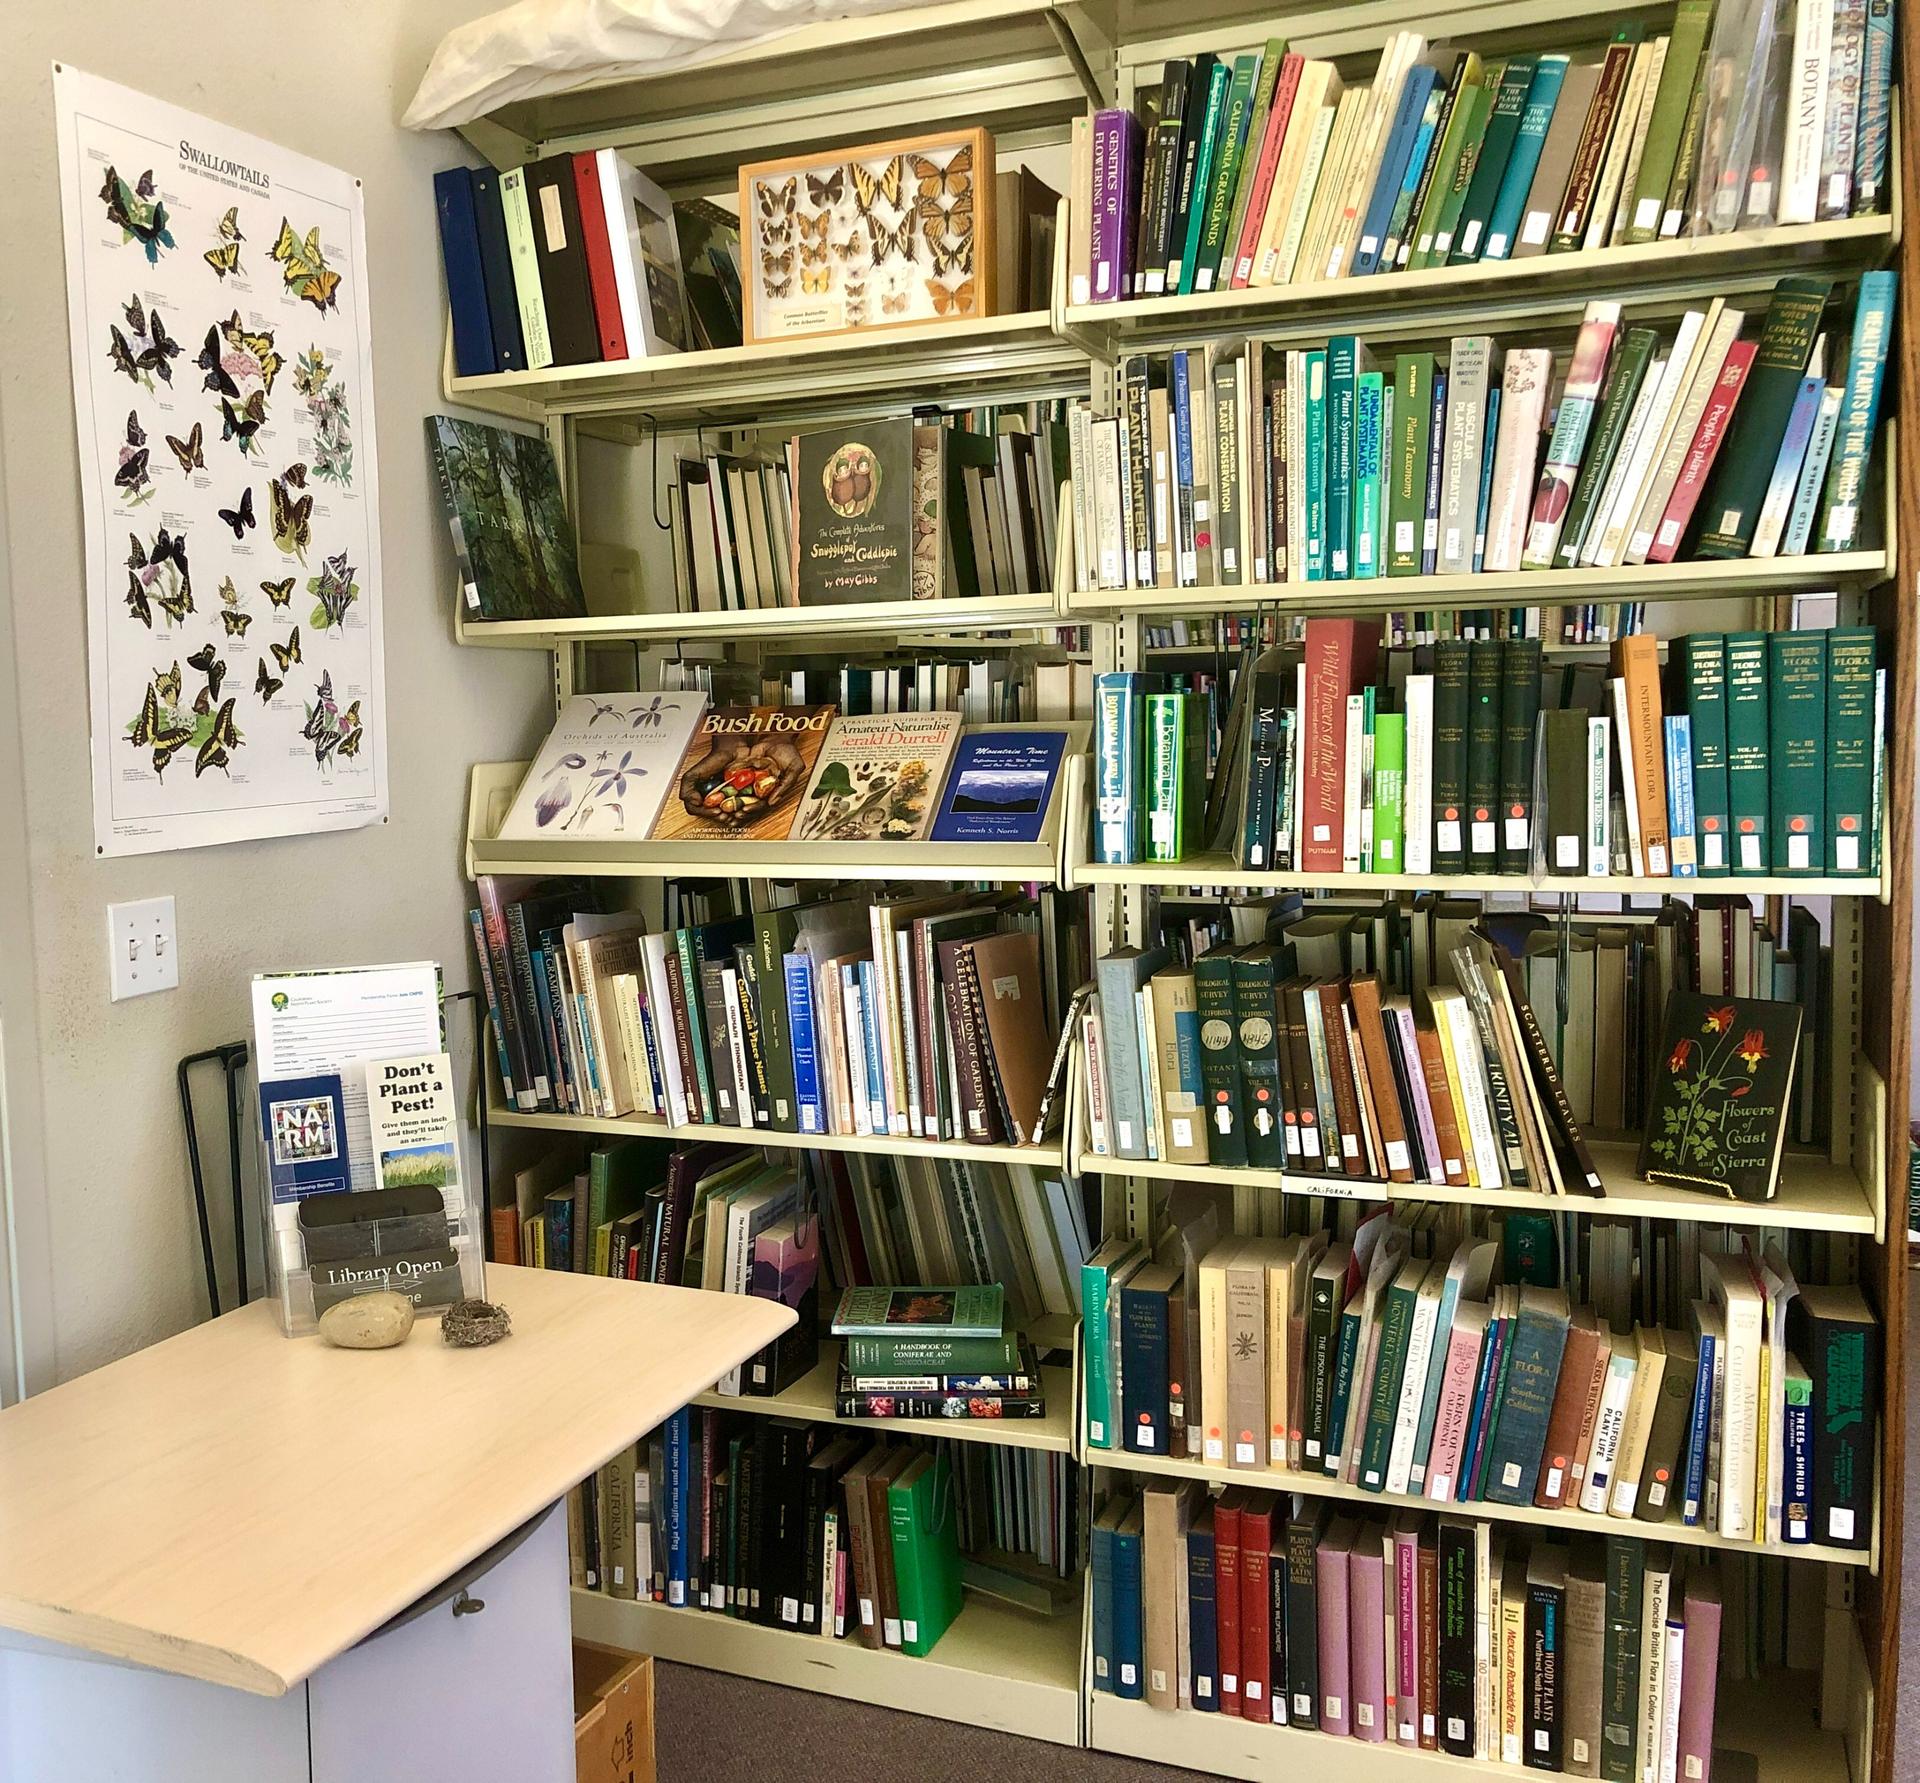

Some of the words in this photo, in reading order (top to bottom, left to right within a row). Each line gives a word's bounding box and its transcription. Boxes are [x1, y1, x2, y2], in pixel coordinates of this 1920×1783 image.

[1800, 58, 1820, 132] BOTANY
[1221, 100, 1240, 169] CALIFORNIA
[180, 140, 270, 189] SWALLOWTAILS
[1108, 131, 1118, 190] GENETICS
[1109, 197, 1118, 215] OF
[1209, 172, 1229, 247] GRASSLANDS
[1859, 309, 1882, 359] HEALTH
[1851, 360, 1874, 410] PLANTS
[1341, 390, 1351, 417] Plant
[1360, 387, 1368, 416] PLANT
[1219, 400, 1229, 434] PLANT
[1369, 390, 1377, 461] FUNDAMENTALS
[1406, 416, 1417, 443] Plant
[1452, 402, 1464, 438] PLANT
[1463, 402, 1474, 459] VASCULAR
[1697, 402, 1726, 451] People's
[1848, 410, 1865, 427] OF
[1340, 420, 1351, 479] Systematics
[1359, 419, 1368, 480] SYSTEMATICS
[1843, 430, 1862, 456] THE
[1220, 436, 1230, 513] CONSERVATION
[1369, 464, 1377, 475] OF
[1403, 446, 1416, 499] Taxonomy
[1449, 441, 1463, 516] SYSTEMATICS
[1683, 448, 1708, 487] plants
[1836, 457, 1858, 503] WORLD
[811, 541, 858, 560] Snugglepot
[856, 546, 898, 562] Cuddlepie
[825, 579, 833, 588] by
[835, 576, 851, 587] May
[852, 575, 878, 586] Gibbs
[1322, 640, 1339, 677] Wild
[1694, 661, 1721, 670] FLORA
[1733, 662, 1761, 670] FLORA
[1784, 658, 1819, 666] FLORA
[1834, 657, 1871, 666] FLORA
[1321, 677, 1338, 734] Flowers
[701, 711, 759, 734] Bush
[765, 711, 830, 733] Food
[836, 723, 891, 735] Amateur
[892, 721, 951, 734] Naturalist
[842, 732, 886, 746] erald
[887, 731, 947, 745] Durrell
[975, 747, 1021, 756] Mountain
[1026, 746, 1049, 756] Time
[1321, 735, 1337, 747] of
[1640, 685, 1653, 768] INTERMOUNTAIN
[1647, 770, 1656, 801] FLORA
[1320, 748, 1337, 768] the
[1320, 768, 1337, 813] World
[957, 827, 986, 835] Kenneth
[998, 827, 1019, 835] Norris
[542, 936, 553, 956] THE
[953, 947, 964, 956] A
[545, 958, 561, 1020] GRAMPIANS
[955, 959, 975, 1041] CELEBRATION
[730, 1005, 739, 1038] CHUMASH
[966, 1042, 977, 1057] OF
[1166, 1042, 1176, 1071] Flora
[1181, 1034, 1192, 1080] Arizona
[384, 1062, 435, 1080] Don't
[734, 1042, 745, 1092] ETHNOBOTANY
[1519, 1003, 1560, 1085] SCATTERED
[1553, 1088, 1583, 1145] LEAVES
[379, 1081, 429, 1098] Plant
[433, 1081, 443, 1091] a
[969, 1060, 985, 1115] GARDENS
[281, 1107, 323, 1129] NA
[391, 1097, 435, 1114] Pest!
[1719, 1099, 1775, 1133] Flowers
[381, 1121, 398, 1129] Give
[400, 1119, 419, 1128] them
[431, 1115, 447, 1124] inch
[387, 1129, 401, 1138] and
[402, 1126, 426, 1137] they'll
[284, 1127, 325, 1149] RM
[1726, 1129, 1766, 1152] Coast
[1699, 1158, 1715, 1168] and
[1713, 1153, 1766, 1178] Sierra
[328, 1266, 392, 1287] Library
[395, 1259, 444, 1278] Open
[1092, 1283, 1100, 1312] MARIN
[1092, 1312, 1100, 1340] FLORA
[1382, 1298, 1401, 1358] MONTEREY
[893, 1351, 933, 1359] CONIFERAE
[901, 1343, 939, 1351] HANDBOOK
[1318, 1335, 1326, 1350] THE
[1316, 1351, 1325, 1377] JEPSON
[1514, 1360, 1551, 1377] FLORA
[1592, 1359, 1604, 1385] SIERRA
[1315, 1377, 1324, 1404] DESERT
[1375, 1358, 1392, 1407] COUNTY
[1731, 1345, 1743, 1415] CALIFORNIA
[1313, 1404, 1323, 1434] MANUAL
[1439, 1391, 1454, 1448] CALIFORNIA
[1450, 1393, 1464, 1428] KERN
[1581, 1385, 1598, 1439] WILDFLOWERS
[1600, 1407, 1612, 1437] PLANT
[672, 1420, 680, 1444] Inseln
[1606, 1410, 1622, 1463] CALIFORNIA
[1796, 1412, 1804, 1443] TREES
[671, 1447, 680, 1468] seine
[1444, 1429, 1460, 1478] COUNTY
[1596, 1439, 1606, 1458] LIFE
[1729, 1419, 1741, 1489] VEGETATION
[1796, 1444, 1804, 1454] and
[671, 1469, 680, 1487] und
[1796, 1456, 1804, 1497] SHRUBS
[611, 1465, 621, 1552] CALIFORNIA
[671, 1488, 679, 1530] California
[671, 1532, 679, 1550] Baja
[1653, 1579, 1662, 1595] The
[1652, 1597, 1661, 1629] Concise
[1506, 1629, 1518, 1668] Mexican
[1650, 1631, 1660, 1658] British
[1478, 1658, 1488, 1674] 100
[1544, 1652, 1556, 1686] WOODY
[1649, 1660, 1659, 1682] Flora
[1669, 1660, 1678, 1680] Wild
[1505, 1669, 1517, 1712] Roadside
[1649, 1684, 1658, 1692] in
[1667, 1682, 1678, 1714] flowers
[1542, 1687, 1554, 1722] PLANTS
[1648, 1694, 1657, 1722] Colour
[1667, 1716, 1676, 1726] of
[1666, 1728, 1676, 1760] Greece
